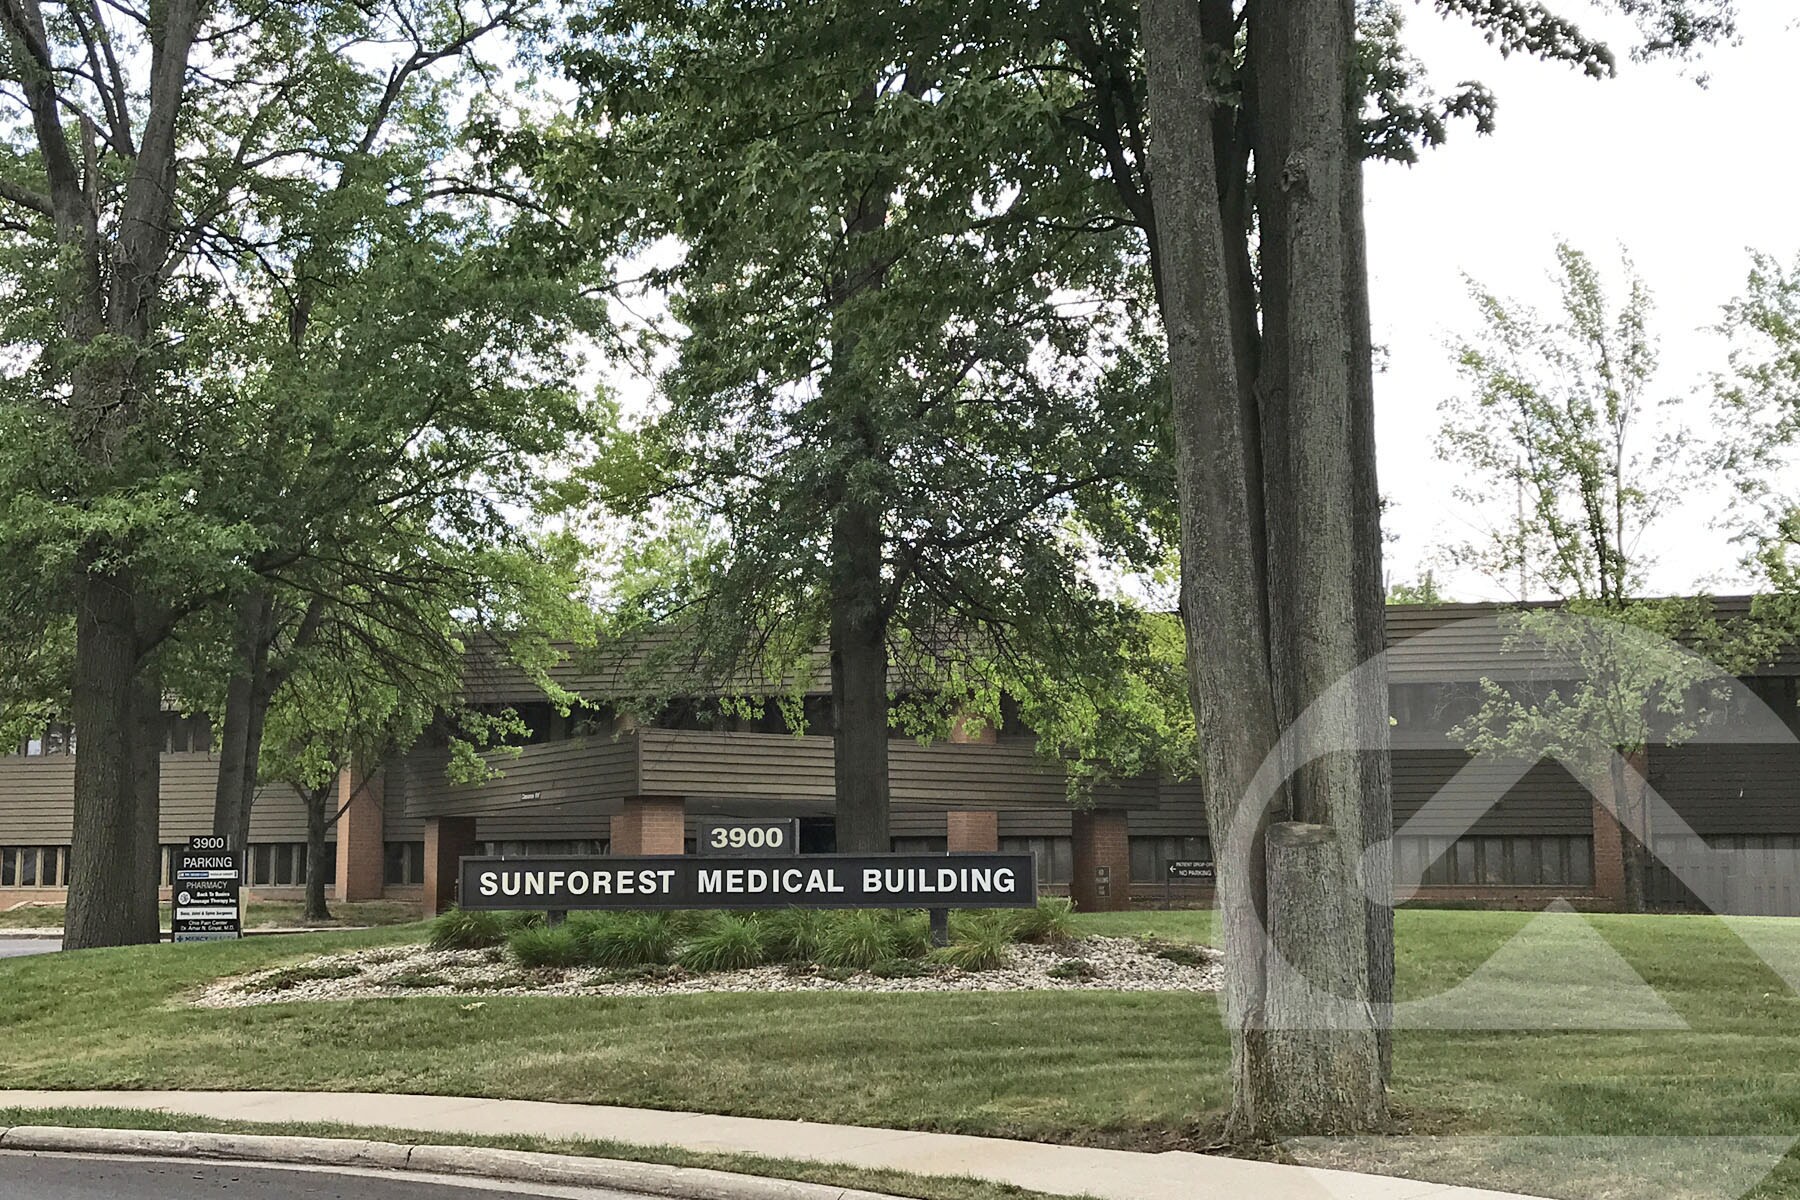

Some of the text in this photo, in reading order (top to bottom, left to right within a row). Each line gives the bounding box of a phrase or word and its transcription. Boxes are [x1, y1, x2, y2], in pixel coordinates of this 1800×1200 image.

[192, 837, 224, 849] 3900
[710, 827, 783, 848] 3900
[183, 856, 233, 868] PARKING
[186, 881, 228, 889] PHARMACY
[479, 868, 1016, 896] SUNFOREST MEDICAL BUILDING
